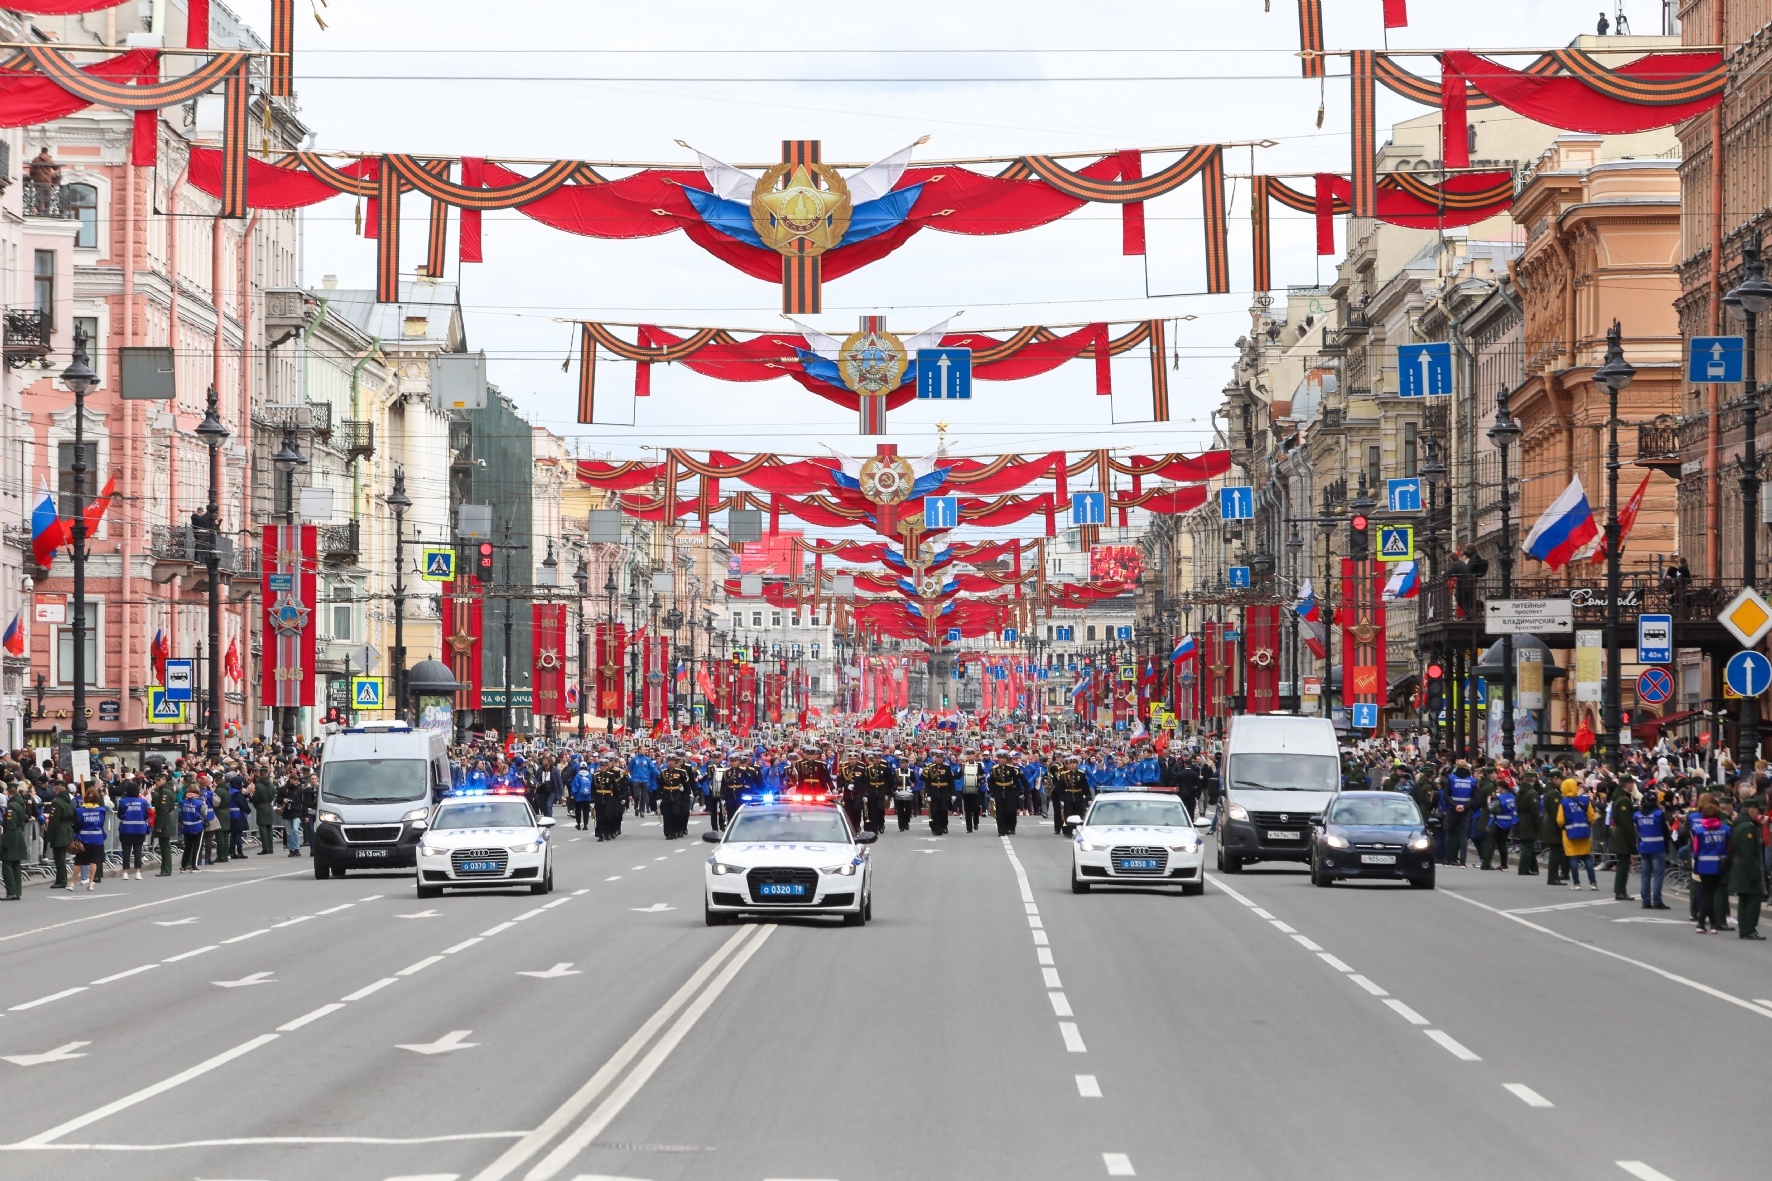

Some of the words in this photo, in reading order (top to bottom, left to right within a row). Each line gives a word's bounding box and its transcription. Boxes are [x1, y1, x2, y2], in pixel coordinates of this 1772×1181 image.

[785, 220, 817, 231] СЛАВА
[1570, 588, 1640, 607] Comode
[1511, 601, 1546, 609] ЛИТЕЙНЫЙ
[1502, 616, 1556, 625] ВЛАДИМИРСКИЙ
[273, 667, 304, 681] 1945
[539, 690, 558, 699] 1945
[1254, 689, 1273, 698] 1945
[495, 695, 533, 703] ФОАЧЧА
[740, 844, 828, 852] ДПС
[470, 862, 487, 870] 0370
[1130, 859, 1146, 867] 0350
[771, 885, 791, 894] 0320
